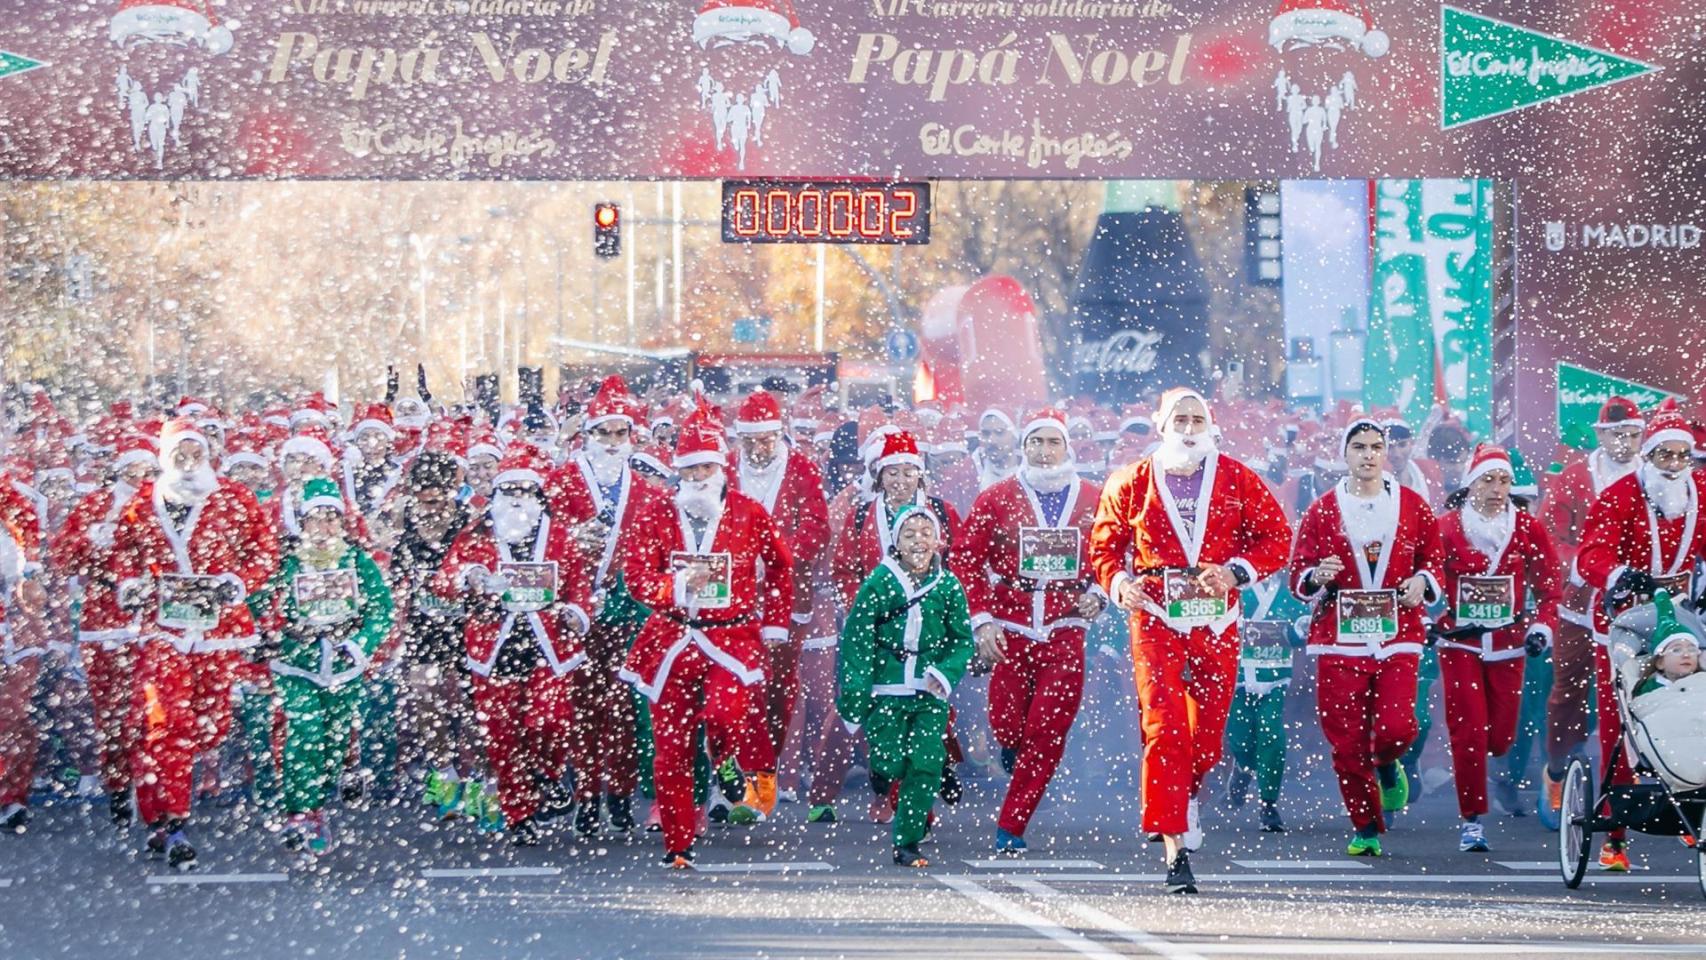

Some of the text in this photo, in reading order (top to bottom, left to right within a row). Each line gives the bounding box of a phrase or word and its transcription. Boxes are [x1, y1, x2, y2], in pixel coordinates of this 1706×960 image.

[916, 0, 1013, 17] Carrera
[1021, 0, 1137, 17] solidaria
[1142, 0, 1173, 17] de
[267, 30, 616, 101] Papá Noel
[847, 31, 1193, 102] Papá Noel
[1447, 45, 1608, 86] El Corte Inglés
[920, 117, 1133, 169] El Corte Inglés
[1583, 223, 1701, 248] MADRID
[1181, 600, 1216, 617] 3565
[1468, 604, 1502, 618] 3419
[1351, 617, 1383, 633] 6891
